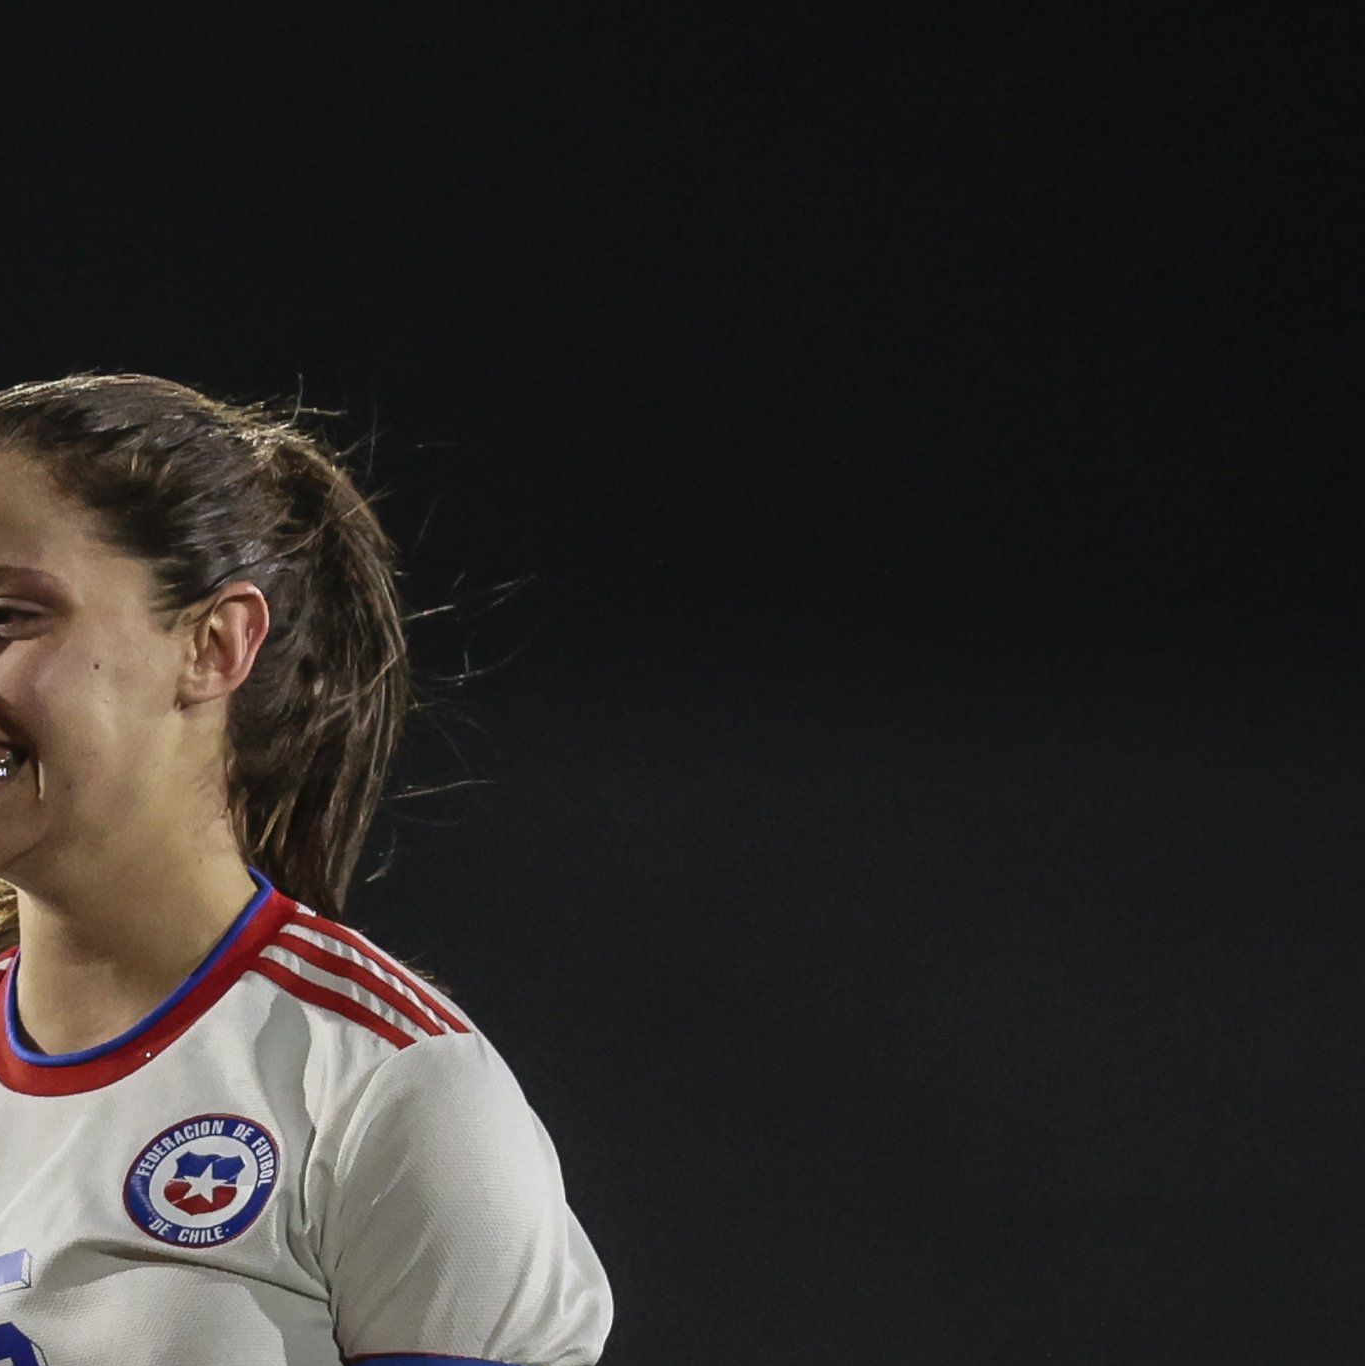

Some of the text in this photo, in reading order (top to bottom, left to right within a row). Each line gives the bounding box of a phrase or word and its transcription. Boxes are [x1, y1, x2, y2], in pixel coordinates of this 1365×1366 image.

[135, 1119, 275, 1188] FEDERACION DE FUTBOL
[148, 1217, 225, 1244] DE CHILE
